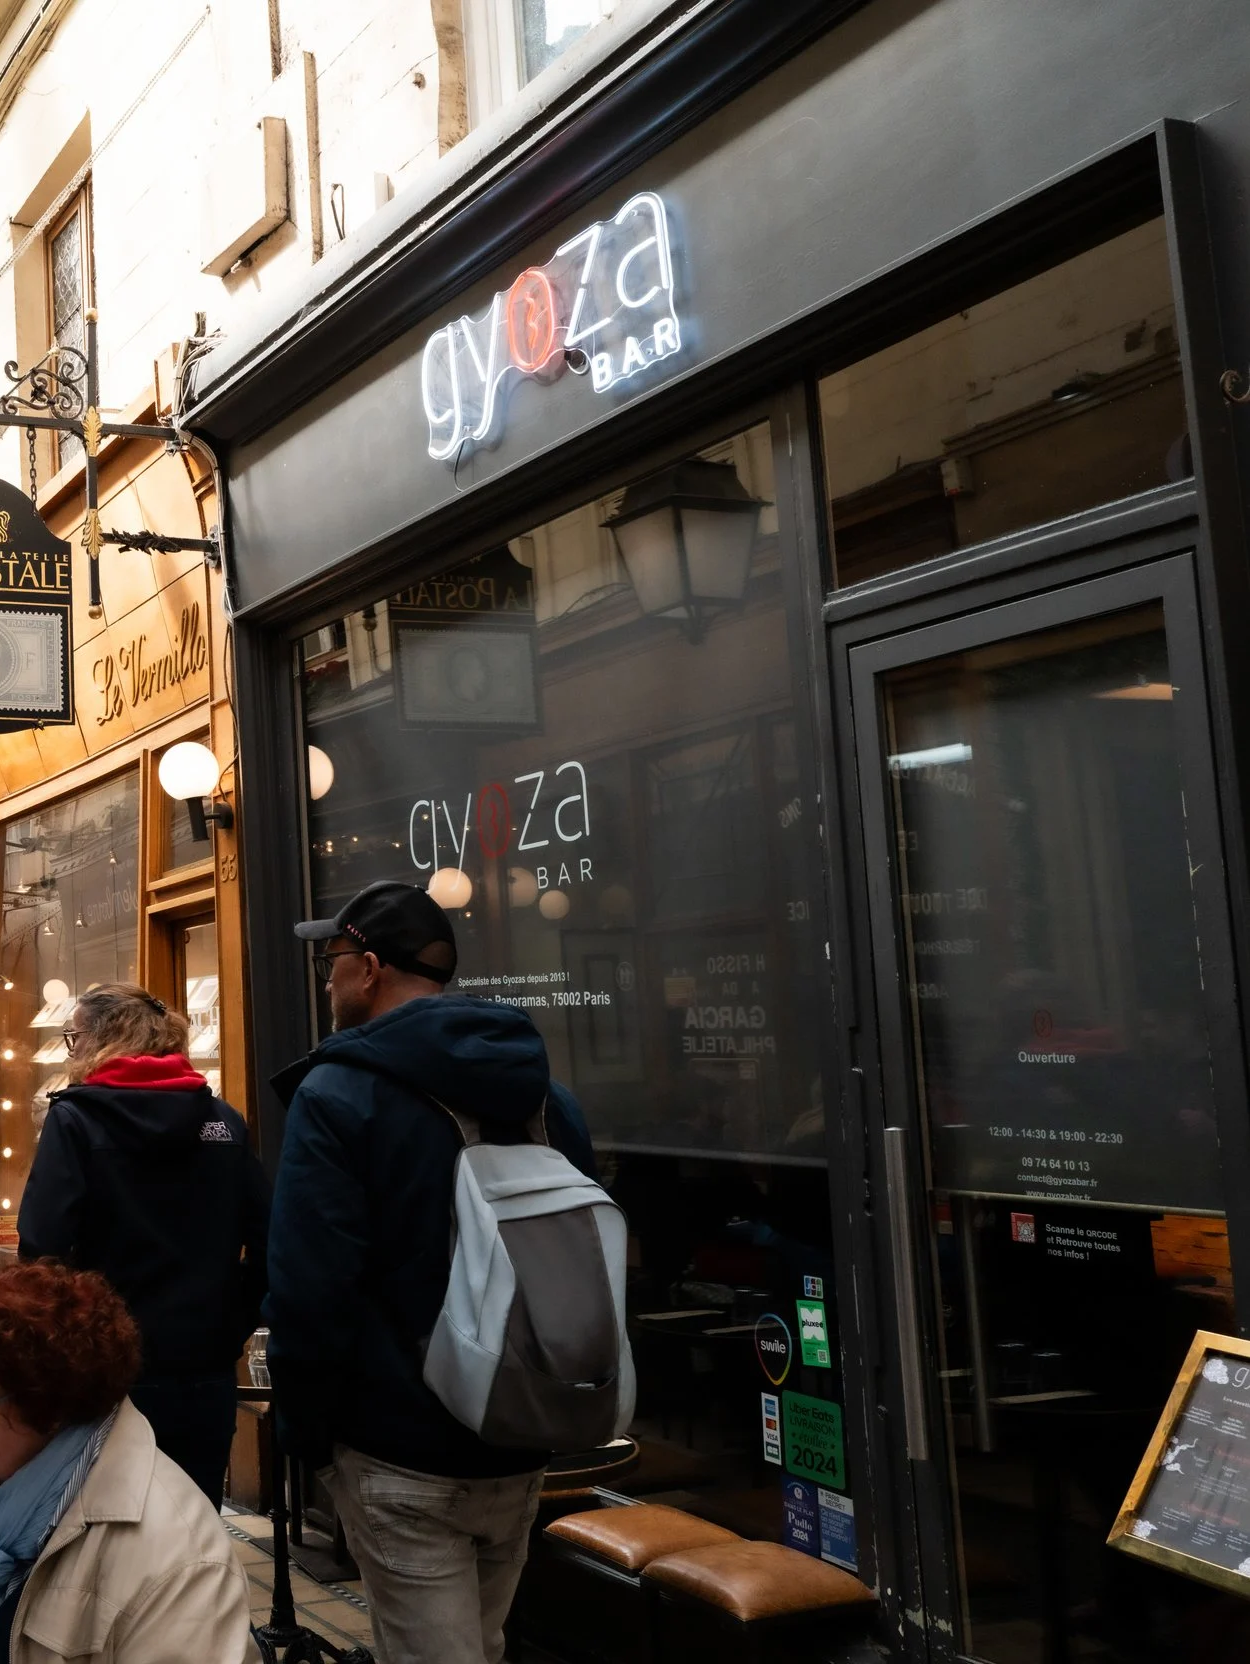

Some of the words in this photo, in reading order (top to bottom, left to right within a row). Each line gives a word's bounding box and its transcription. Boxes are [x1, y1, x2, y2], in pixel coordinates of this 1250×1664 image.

[421, 191, 671, 461] gyoza
[592, 316, 680, 393] BAR
[24, 651, 36, 669] F
[92, 653, 123, 727] Le
[119, 600, 208, 708] Vermillo
[220, 854, 238, 884] 55
[537, 858, 593, 890] BAR
[458, 977, 489, 988] Spécialiste
[490, 977, 501, 985] des
[502, 975, 526, 986] Gyozas
[527, 974, 549, 985] depuis
[549, 972, 566, 982] 2013
[495, 994, 550, 1008] Panoramas,
[552, 992, 581, 1006] 75002
[583, 991, 611, 1006] Paris
[1018, 1051, 1076, 1064] Ouverture
[988, 1126, 1013, 1138] 12:00
[1021, 1128, 1047, 1140] 14:30
[1050, 1130, 1057, 1140] &
[1059, 1130, 1086, 1142] 19:00
[1095, 1132, 1123, 1144] 22:30
[1021, 1157, 1033, 1167] 09
[1035, 1158, 1047, 1169] 74
[1049, 1159, 1061, 1169] 64
[1063, 1160, 1075, 1171] 10
[1078, 1161, 1090, 1172] 13
[1017, 1173, 1098, 1188] contact@gyozabar.fr
[1045, 1224, 1075, 1236] Scanne
[1076, 1227, 1084, 1236] le
[1086, 1229, 1118, 1240] QRCODE
[1046, 1237, 1055, 1245] et
[1055, 1237, 1092, 1249] Retrouve
[1094, 1241, 1121, 1252] toutes
[1047, 1249, 1062, 1257] nos
[1064, 1249, 1085, 1260] infos
[801, 1319, 824, 1328] pluxee
[760, 1339, 787, 1354] swile
[790, 1402, 810, 1417] Uber
[812, 1407, 835, 1424] Eats
[790, 1416, 836, 1437] LIVRAISON
[766, 1432, 779, 1442] VISA
[791, 1445, 838, 1477] 2024
[788, 1510, 813, 1531] Pudlo
[792, 1527, 809, 1542] 2024
